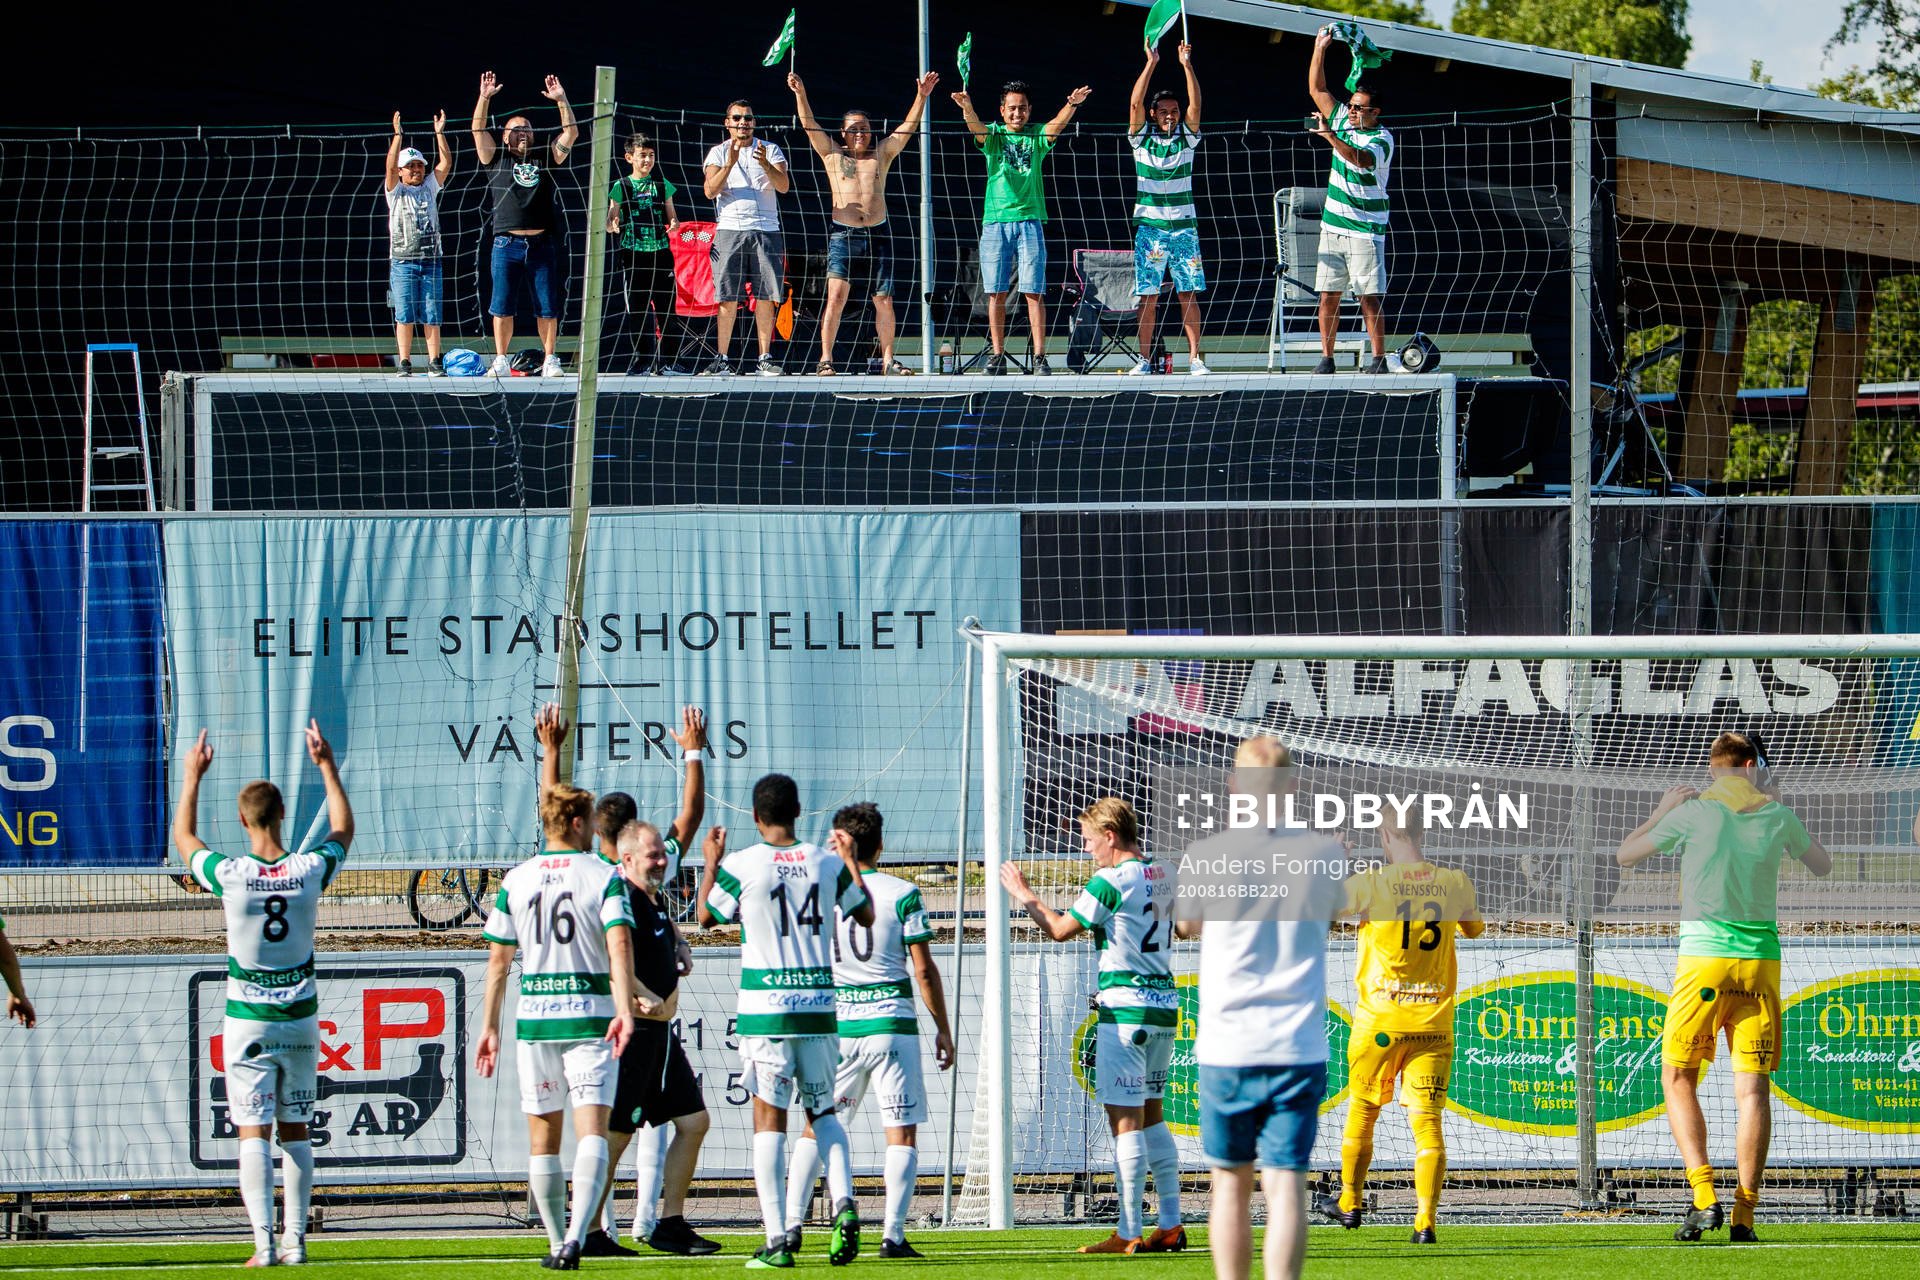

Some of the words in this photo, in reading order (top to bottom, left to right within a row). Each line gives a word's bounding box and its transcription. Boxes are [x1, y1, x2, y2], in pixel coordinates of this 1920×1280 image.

[254, 616, 408, 658] ELITE
[447, 709, 749, 763] VÄTERS
[777, 865, 808, 879] SPAN
[1392, 882, 1447, 896] SVENSSON
[263, 895, 289, 943] 8
[529, 891, 576, 945] 16
[770, 882, 823, 937] 14
[1396, 899, 1443, 951] 13
[1464, 1047, 1554, 1066] Konditori
[1806, 1044, 1897, 1064] Konditori
[1419, 1075, 1445, 1087] TEXAS
[347, 1102, 416, 1137] AB
